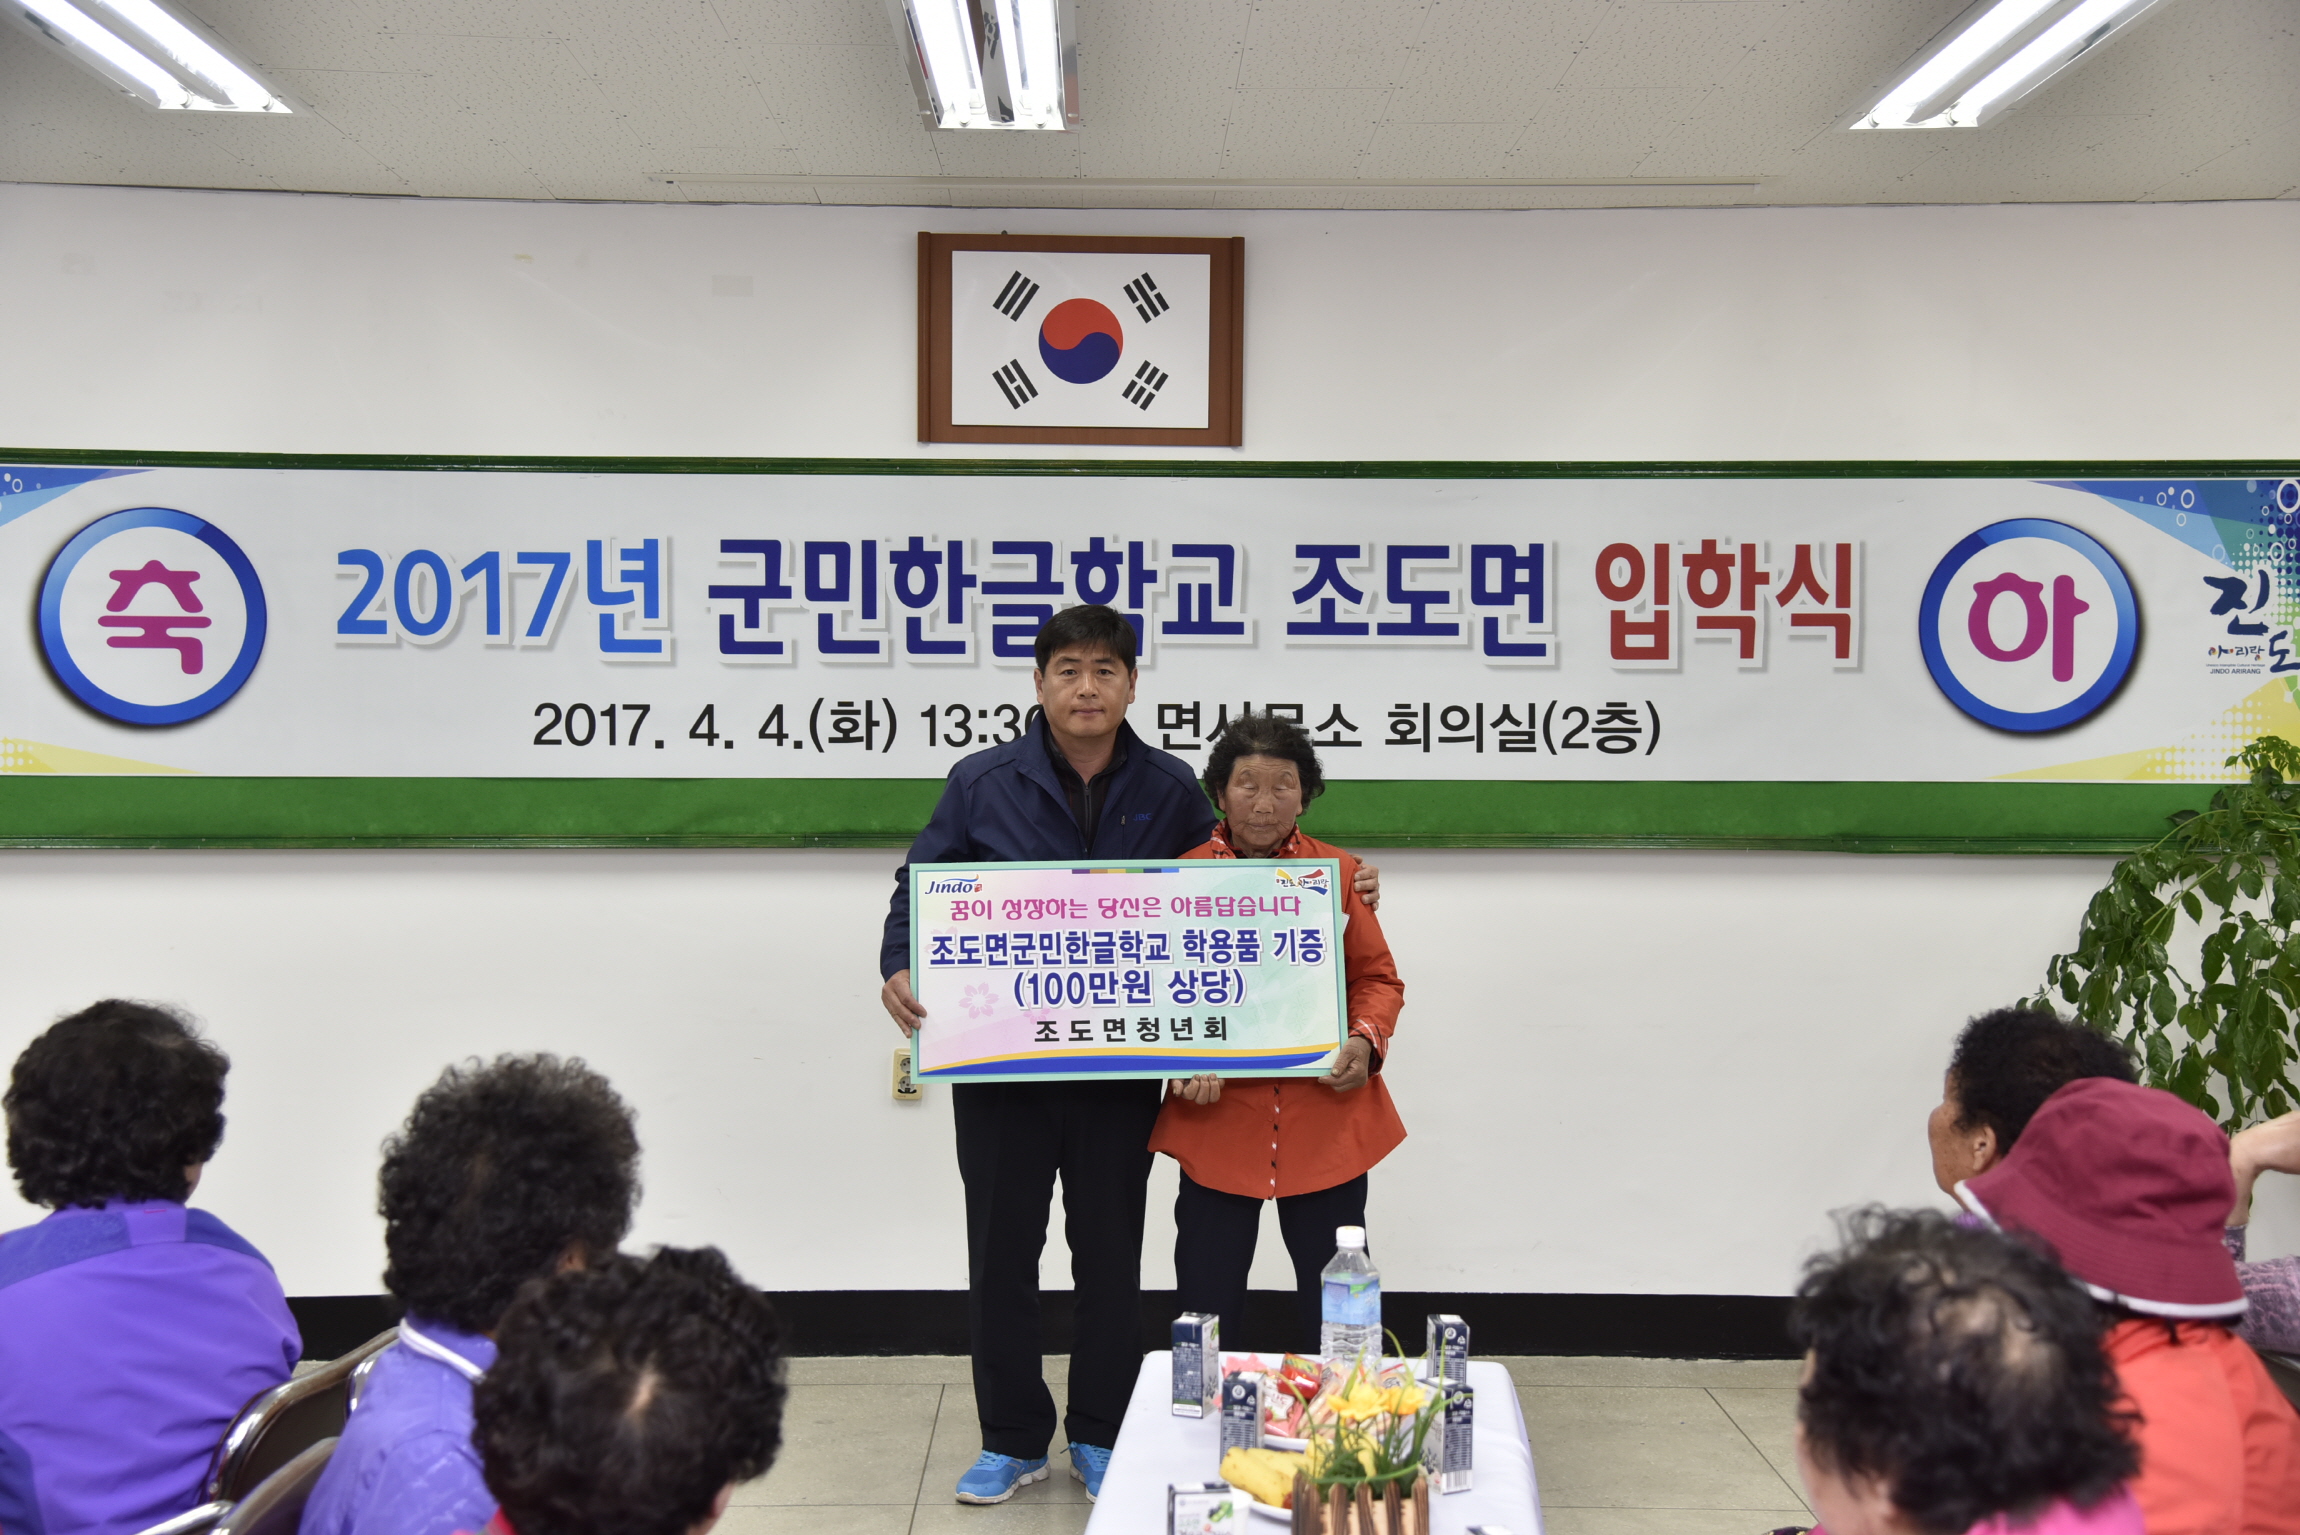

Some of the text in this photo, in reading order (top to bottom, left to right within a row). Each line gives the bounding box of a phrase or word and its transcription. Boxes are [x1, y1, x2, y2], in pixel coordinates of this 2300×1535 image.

[98, 559, 212, 675] 축
[337, 536, 1852, 660] 2017년 군민한글학교 조도면 입학식
[1968, 571, 2090, 682] 하
[533, 702, 664, 749] 2017.
[688, 703, 734, 749] 4.
[758, 697, 897, 754] 4.(화)
[1157, 700, 1362, 750] 면소
[1385, 700, 1661, 756] 회의실(2층)
[924, 880, 973, 895] Jindo
[950, 894, 1302, 921] 꿈이 성장하는 당신은 아름답습니다
[930, 927, 1325, 967] 조도면군민한글학교 학용품 기증
[1013, 968, 1246, 1007] (100만원 상당)
[1034, 1016, 1228, 1043] 조도면청년회
